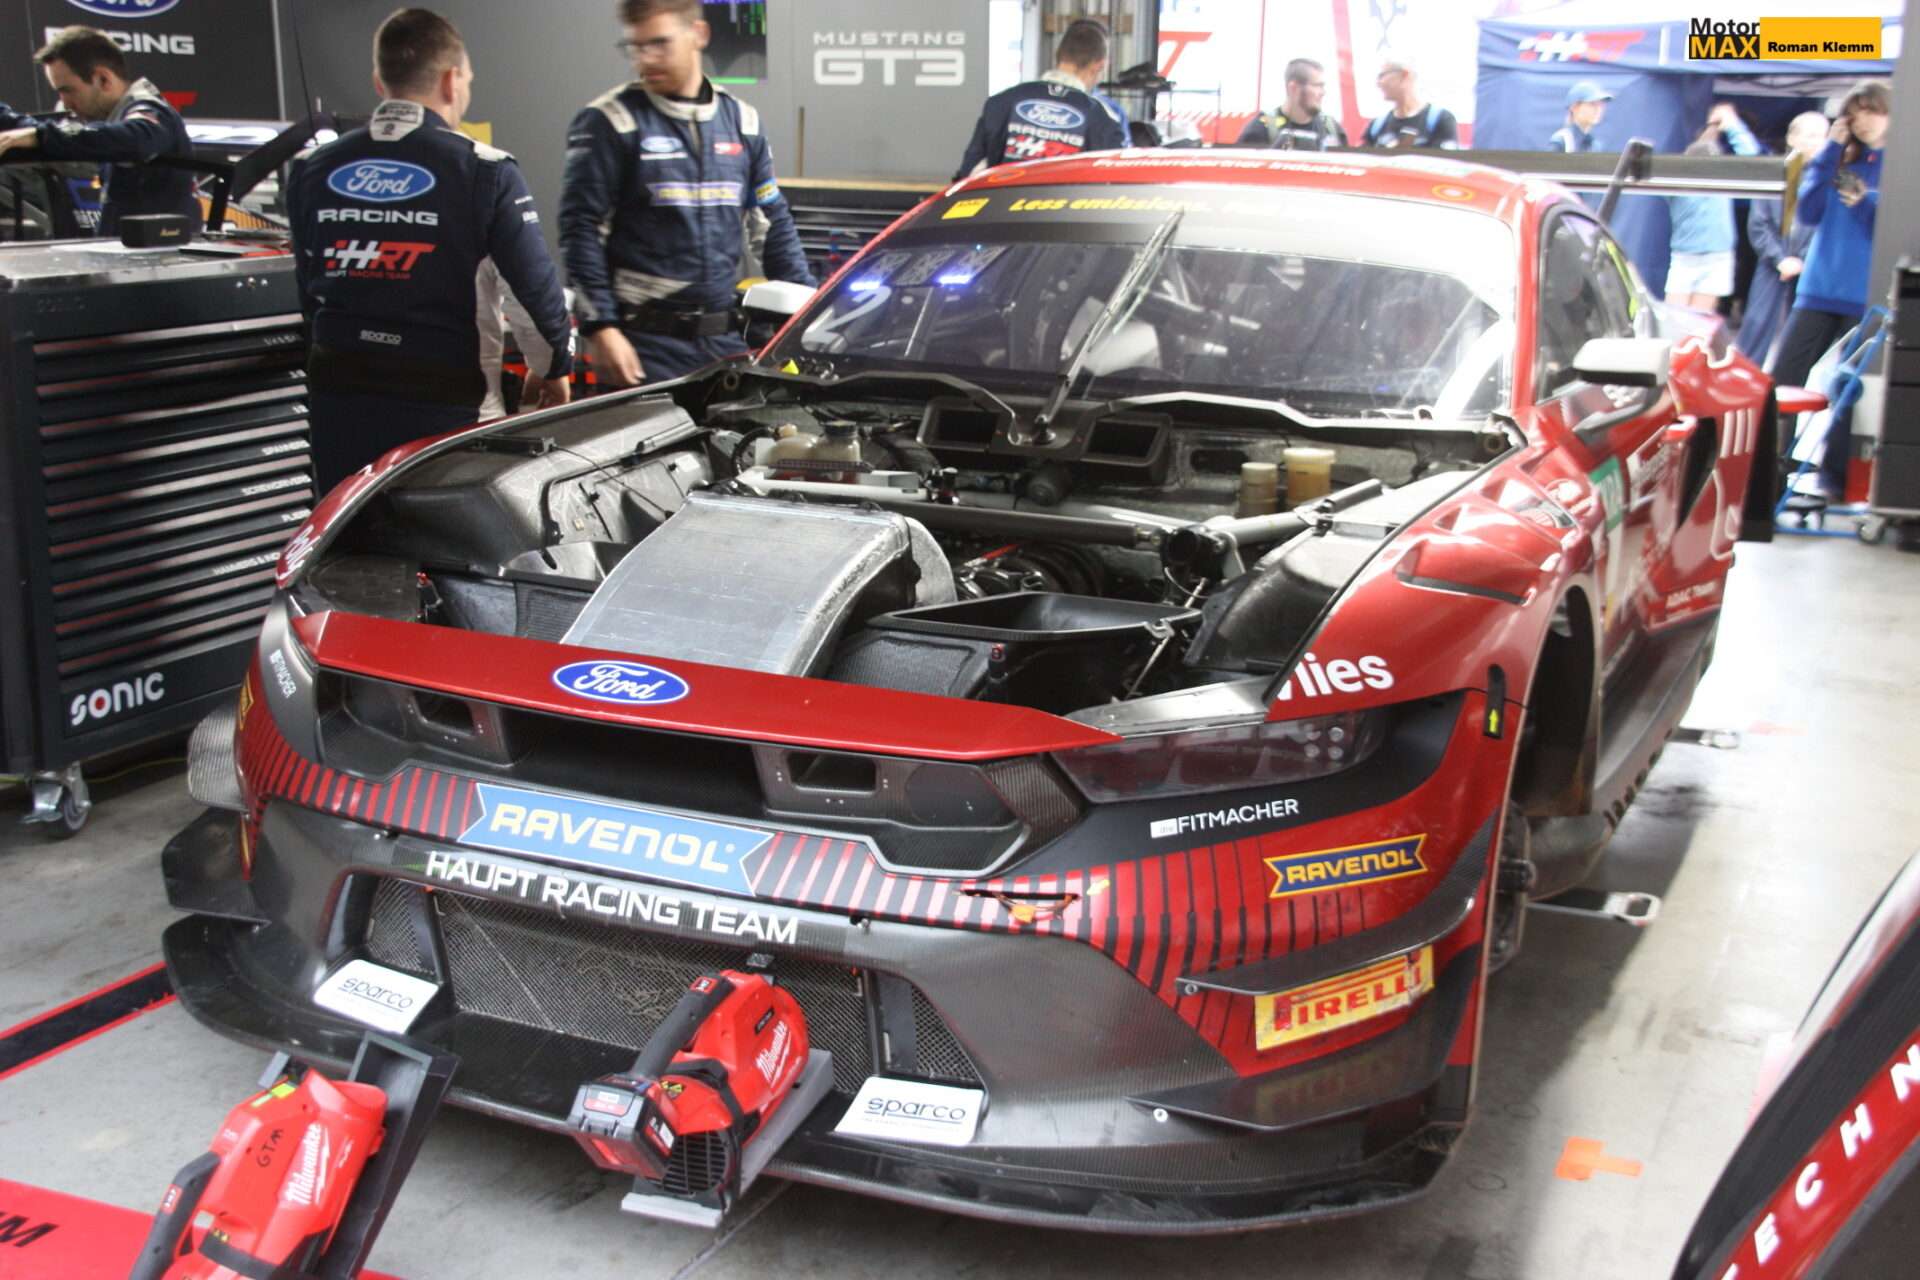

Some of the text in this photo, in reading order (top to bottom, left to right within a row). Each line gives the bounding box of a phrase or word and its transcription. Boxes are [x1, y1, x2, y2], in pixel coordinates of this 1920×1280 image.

[45, 27, 195, 55] CING
[814, 31, 965, 45] MUSTANG
[814, 49, 965, 86] GT3
[1027, 104, 1073, 125] Ford
[1007, 122, 1084, 147] RACING
[347, 163, 413, 195] Ford
[317, 208, 439, 226] RACING
[1008, 198, 1067, 211] Less
[324, 240, 437, 271] HRT
[573, 663, 664, 700] Ford
[1177, 799, 1299, 834] FITMACHER
[490, 803, 729, 873] RAVENOL
[1286, 848, 1414, 884] RAVENOL
[426, 851, 799, 944] HAUPT RACING TEAM
[342, 978, 414, 1009] sparco
[1273, 950, 1421, 1031] PIRELLI
[868, 1097, 966, 1120] sparco
[285, 1123, 322, 1205] Milwaukee
